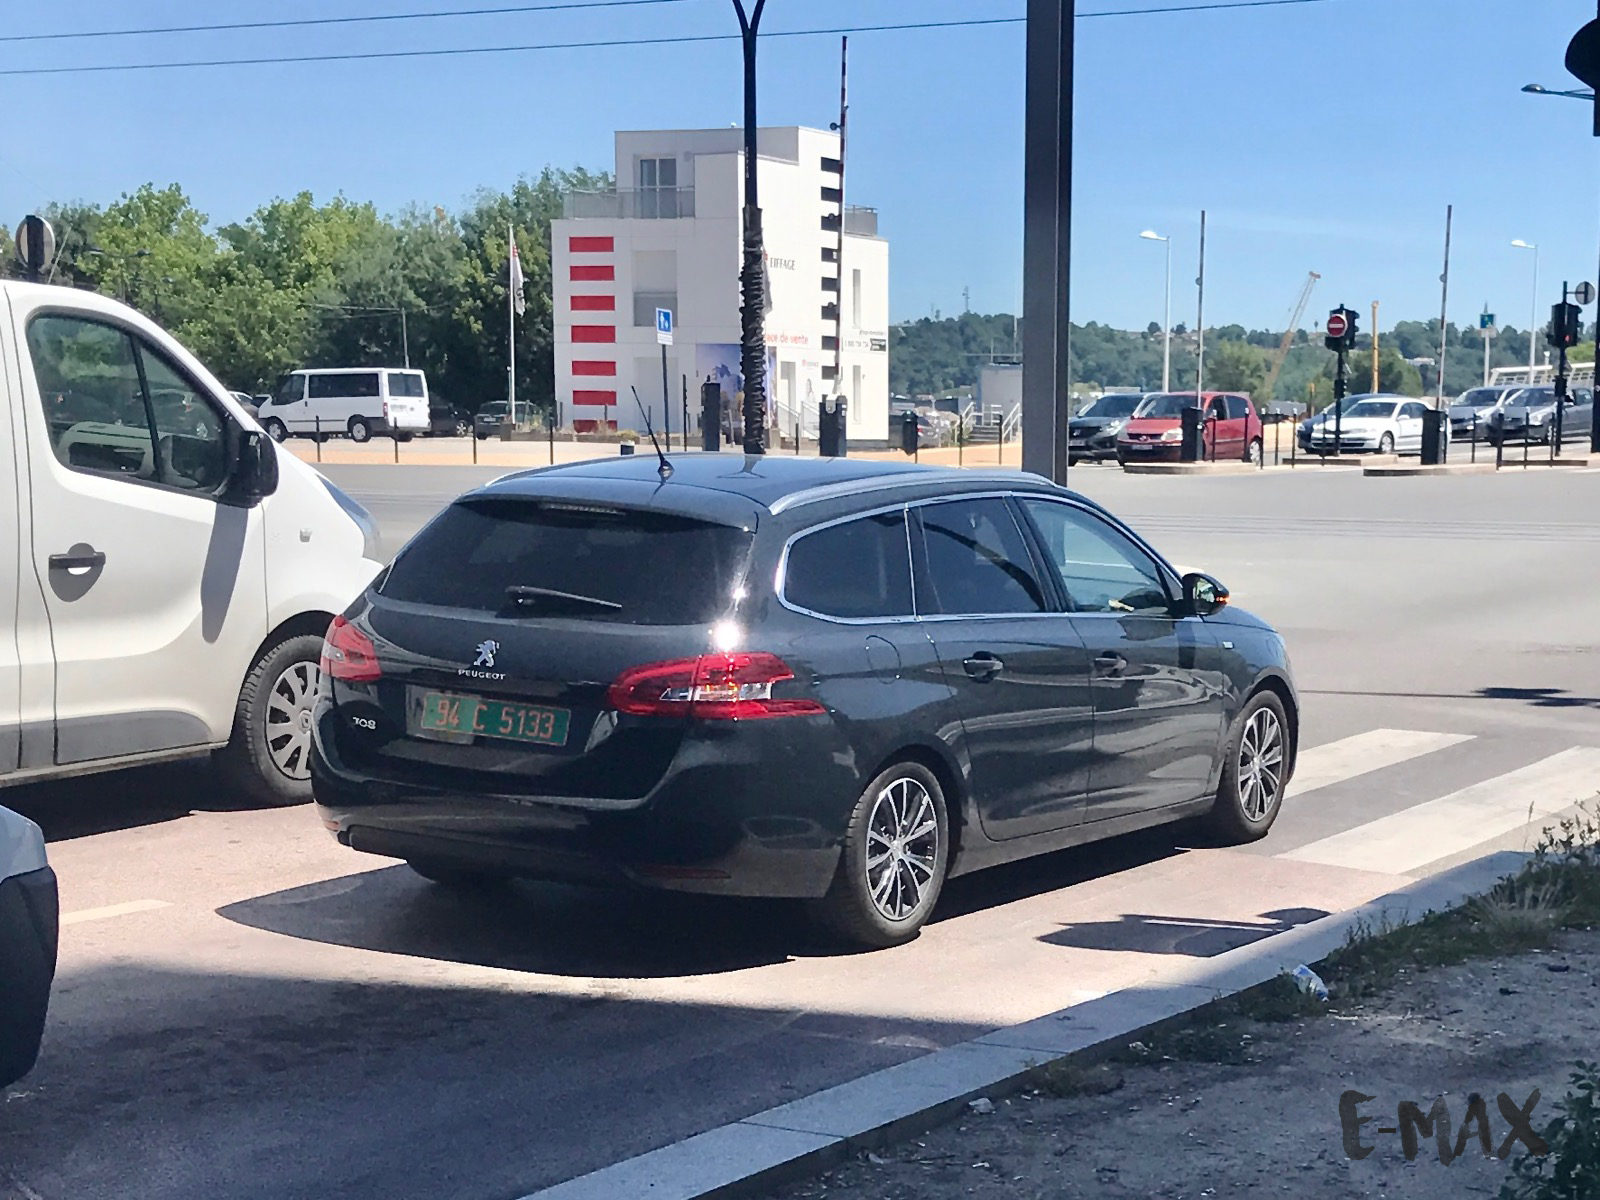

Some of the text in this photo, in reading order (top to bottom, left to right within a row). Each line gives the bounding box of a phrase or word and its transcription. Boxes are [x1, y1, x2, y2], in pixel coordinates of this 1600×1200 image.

[769, 257, 796, 271] EIFFAGE
[790, 333, 809, 345] vente
[457, 668, 506, 680] PEUGEOT
[436, 700, 555, 739] 94 C 5133
